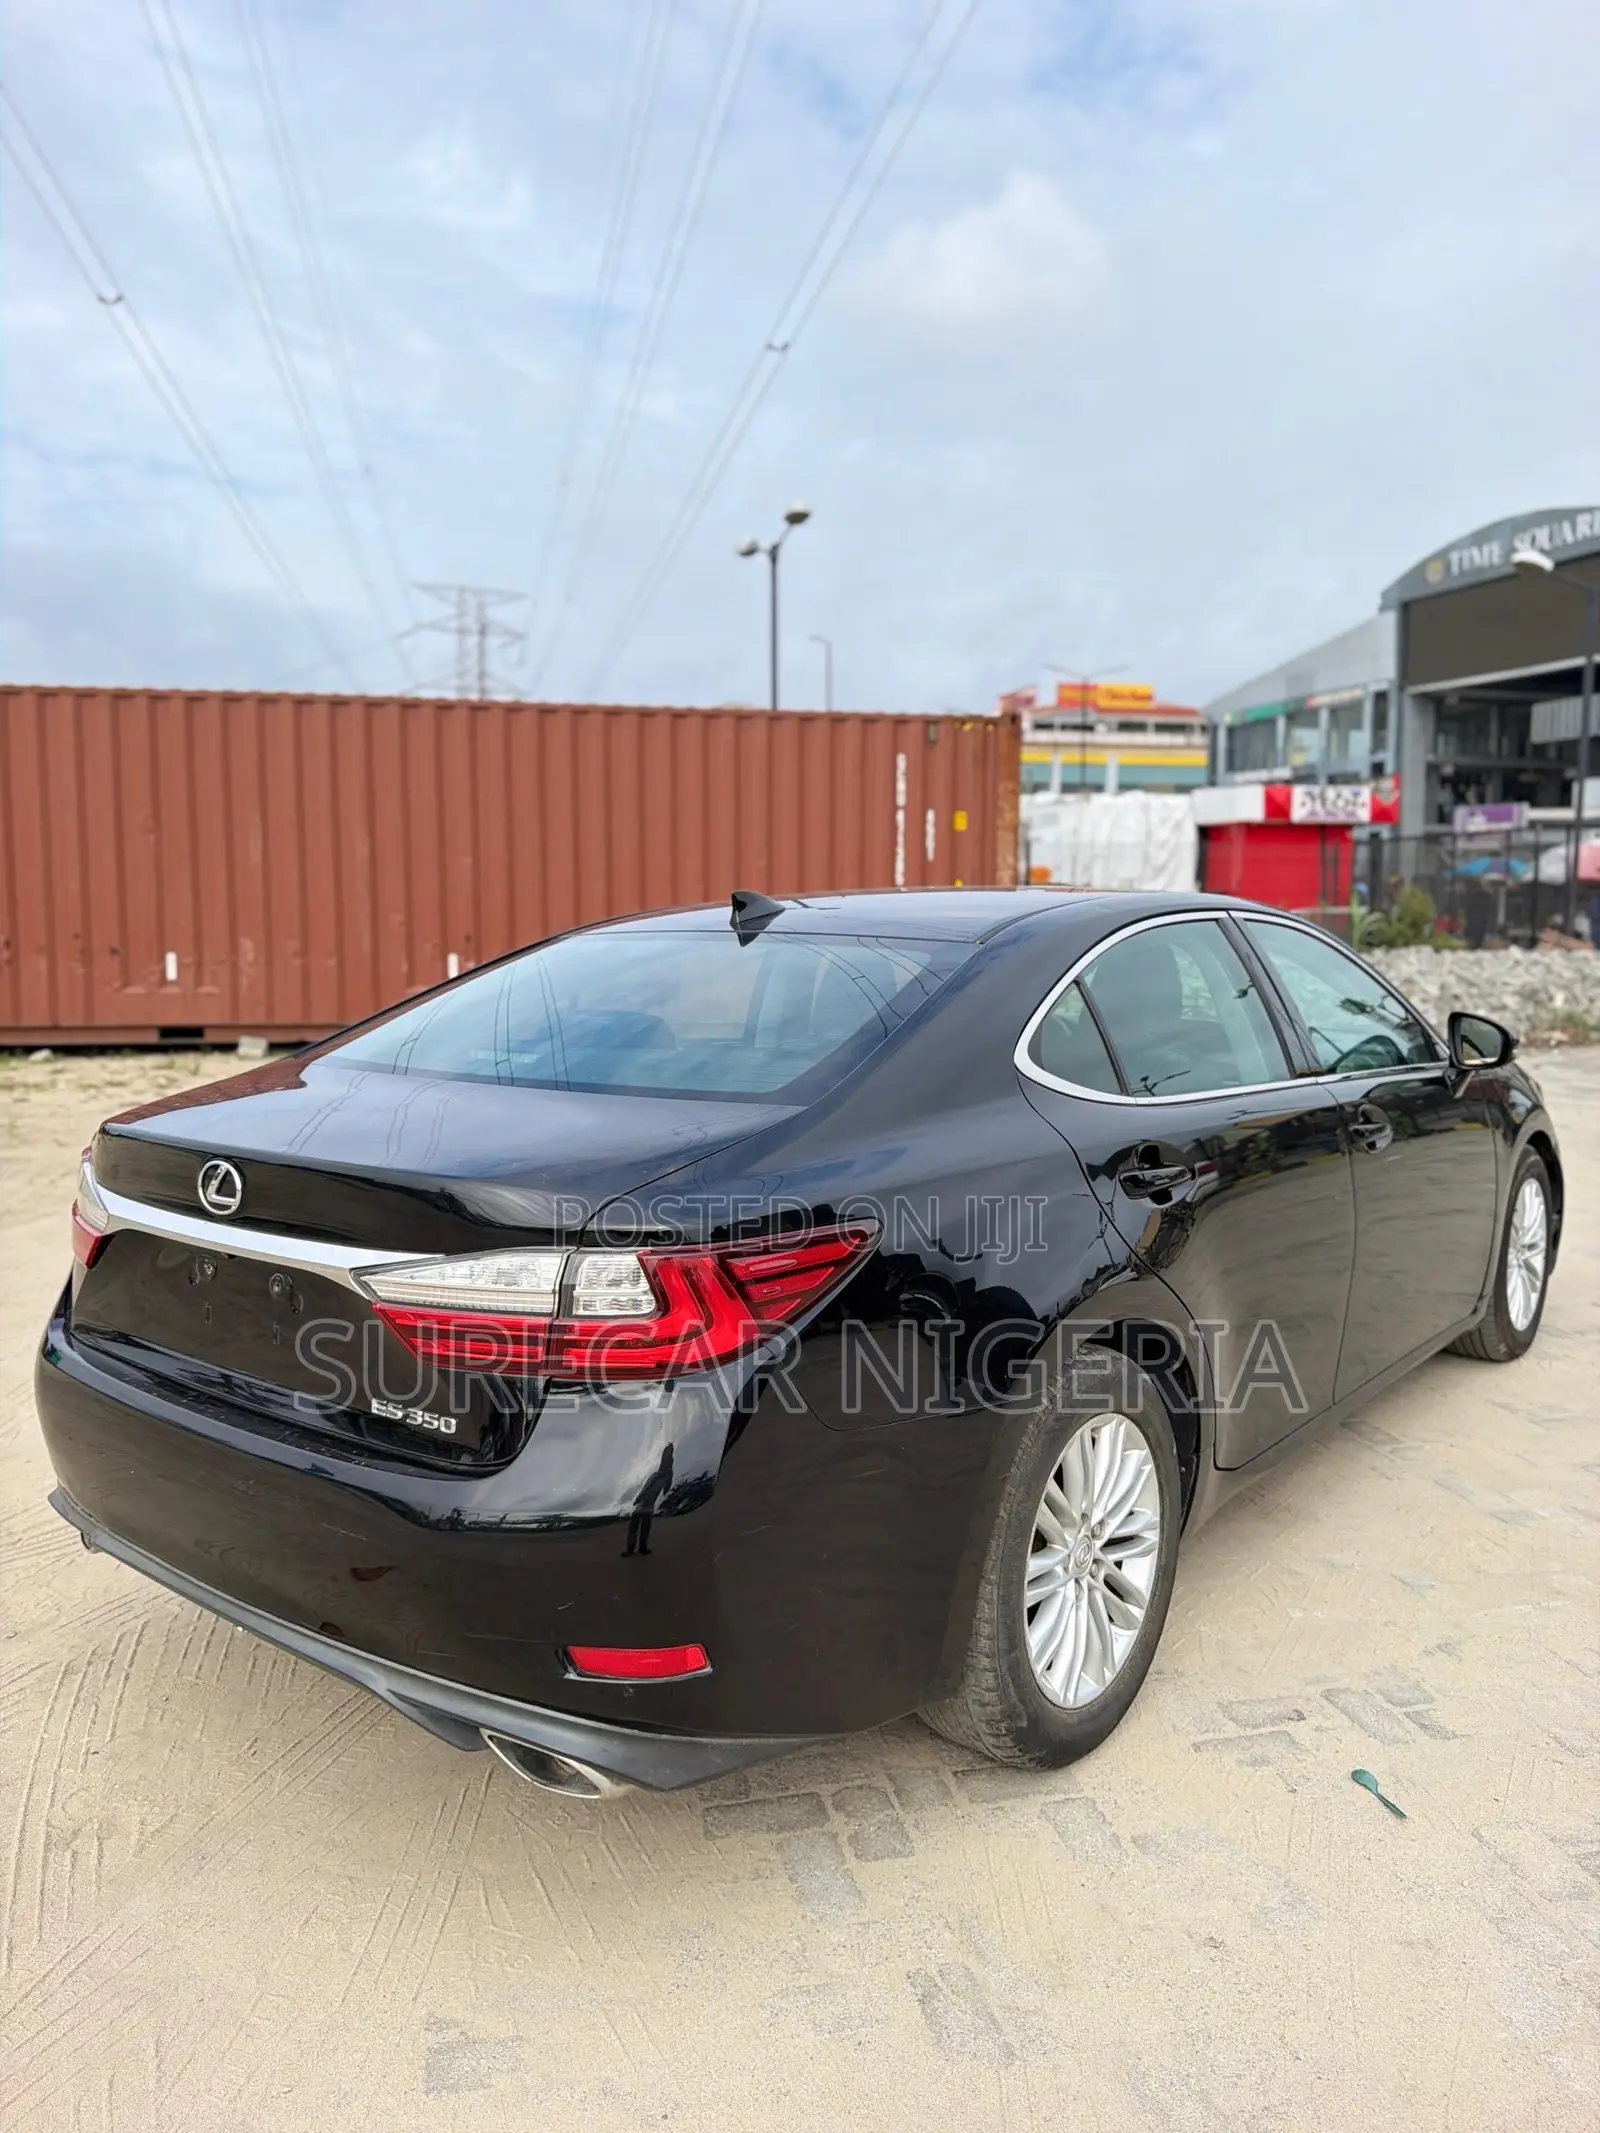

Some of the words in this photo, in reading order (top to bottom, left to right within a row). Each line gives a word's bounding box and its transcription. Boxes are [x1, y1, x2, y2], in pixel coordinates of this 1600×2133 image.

[1450, 541, 1503, 575] TIME
[371, 1398, 403, 1419] ES
[406, 1407, 456, 1433] 350
